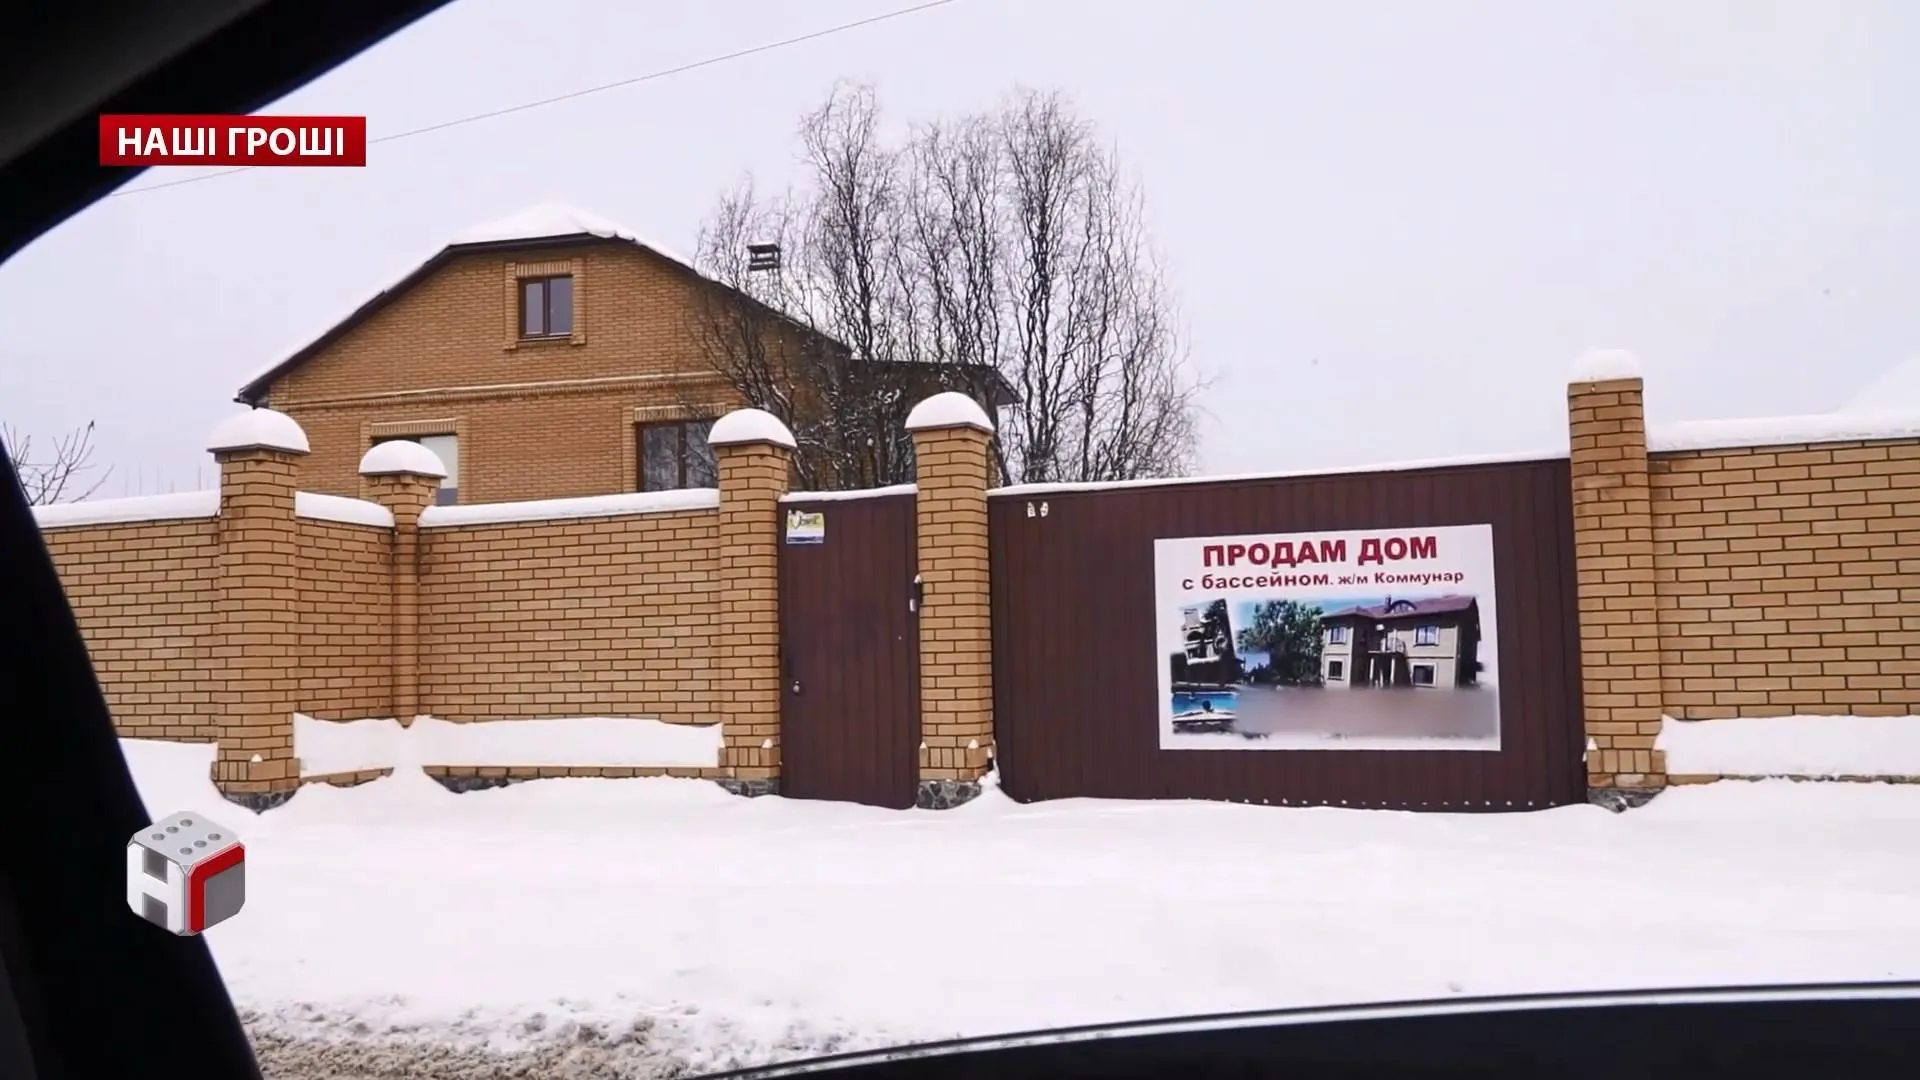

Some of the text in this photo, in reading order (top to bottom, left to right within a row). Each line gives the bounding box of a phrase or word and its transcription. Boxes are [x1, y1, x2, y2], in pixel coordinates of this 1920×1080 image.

[1202, 535, 1438, 568] ПРОДАМ ДОМ
[1181, 577, 1195, 591] с
[1337, 573, 1369, 586] ж/м
[1374, 570, 1464, 587] Коммунар
